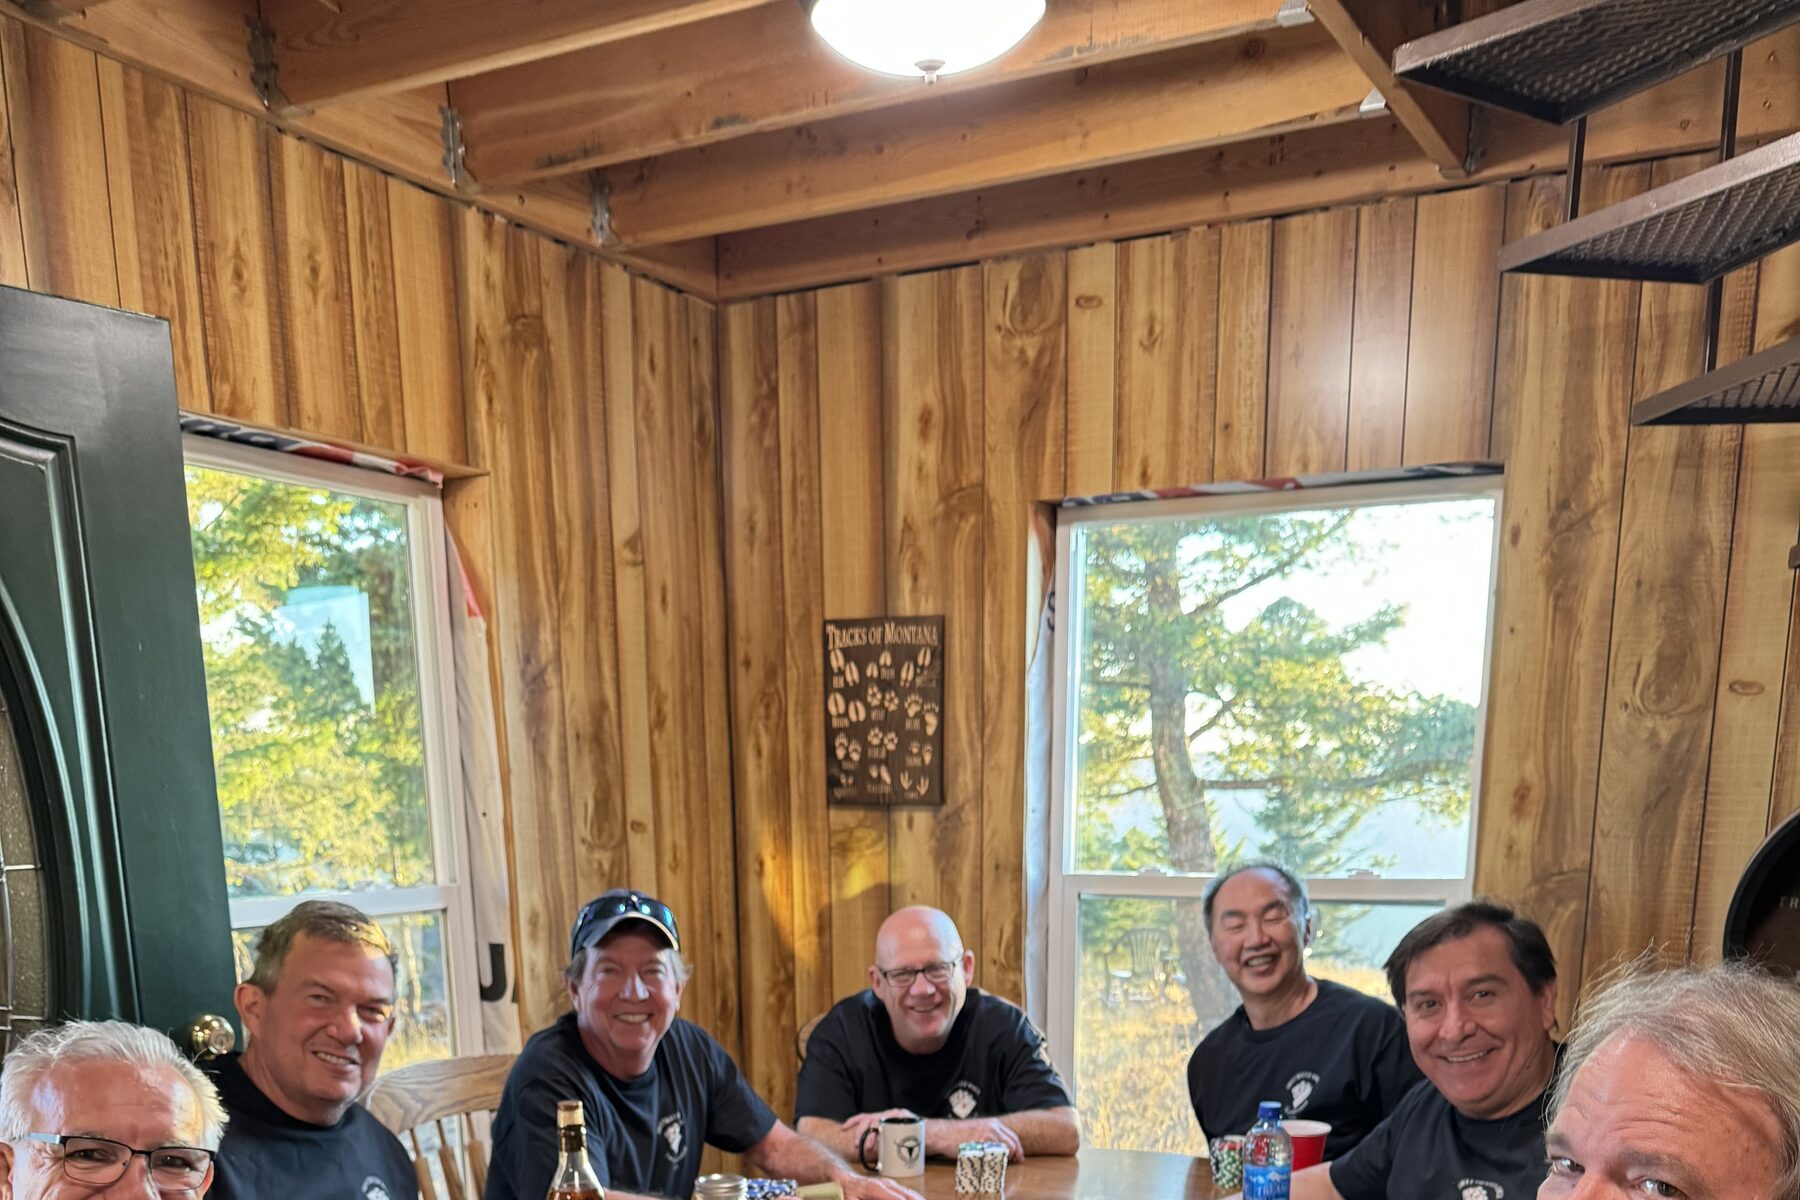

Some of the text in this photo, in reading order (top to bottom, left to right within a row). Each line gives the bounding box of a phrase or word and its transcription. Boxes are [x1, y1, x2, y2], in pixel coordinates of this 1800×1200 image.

[826, 620, 938, 650] TRACKS OF MONTANA
